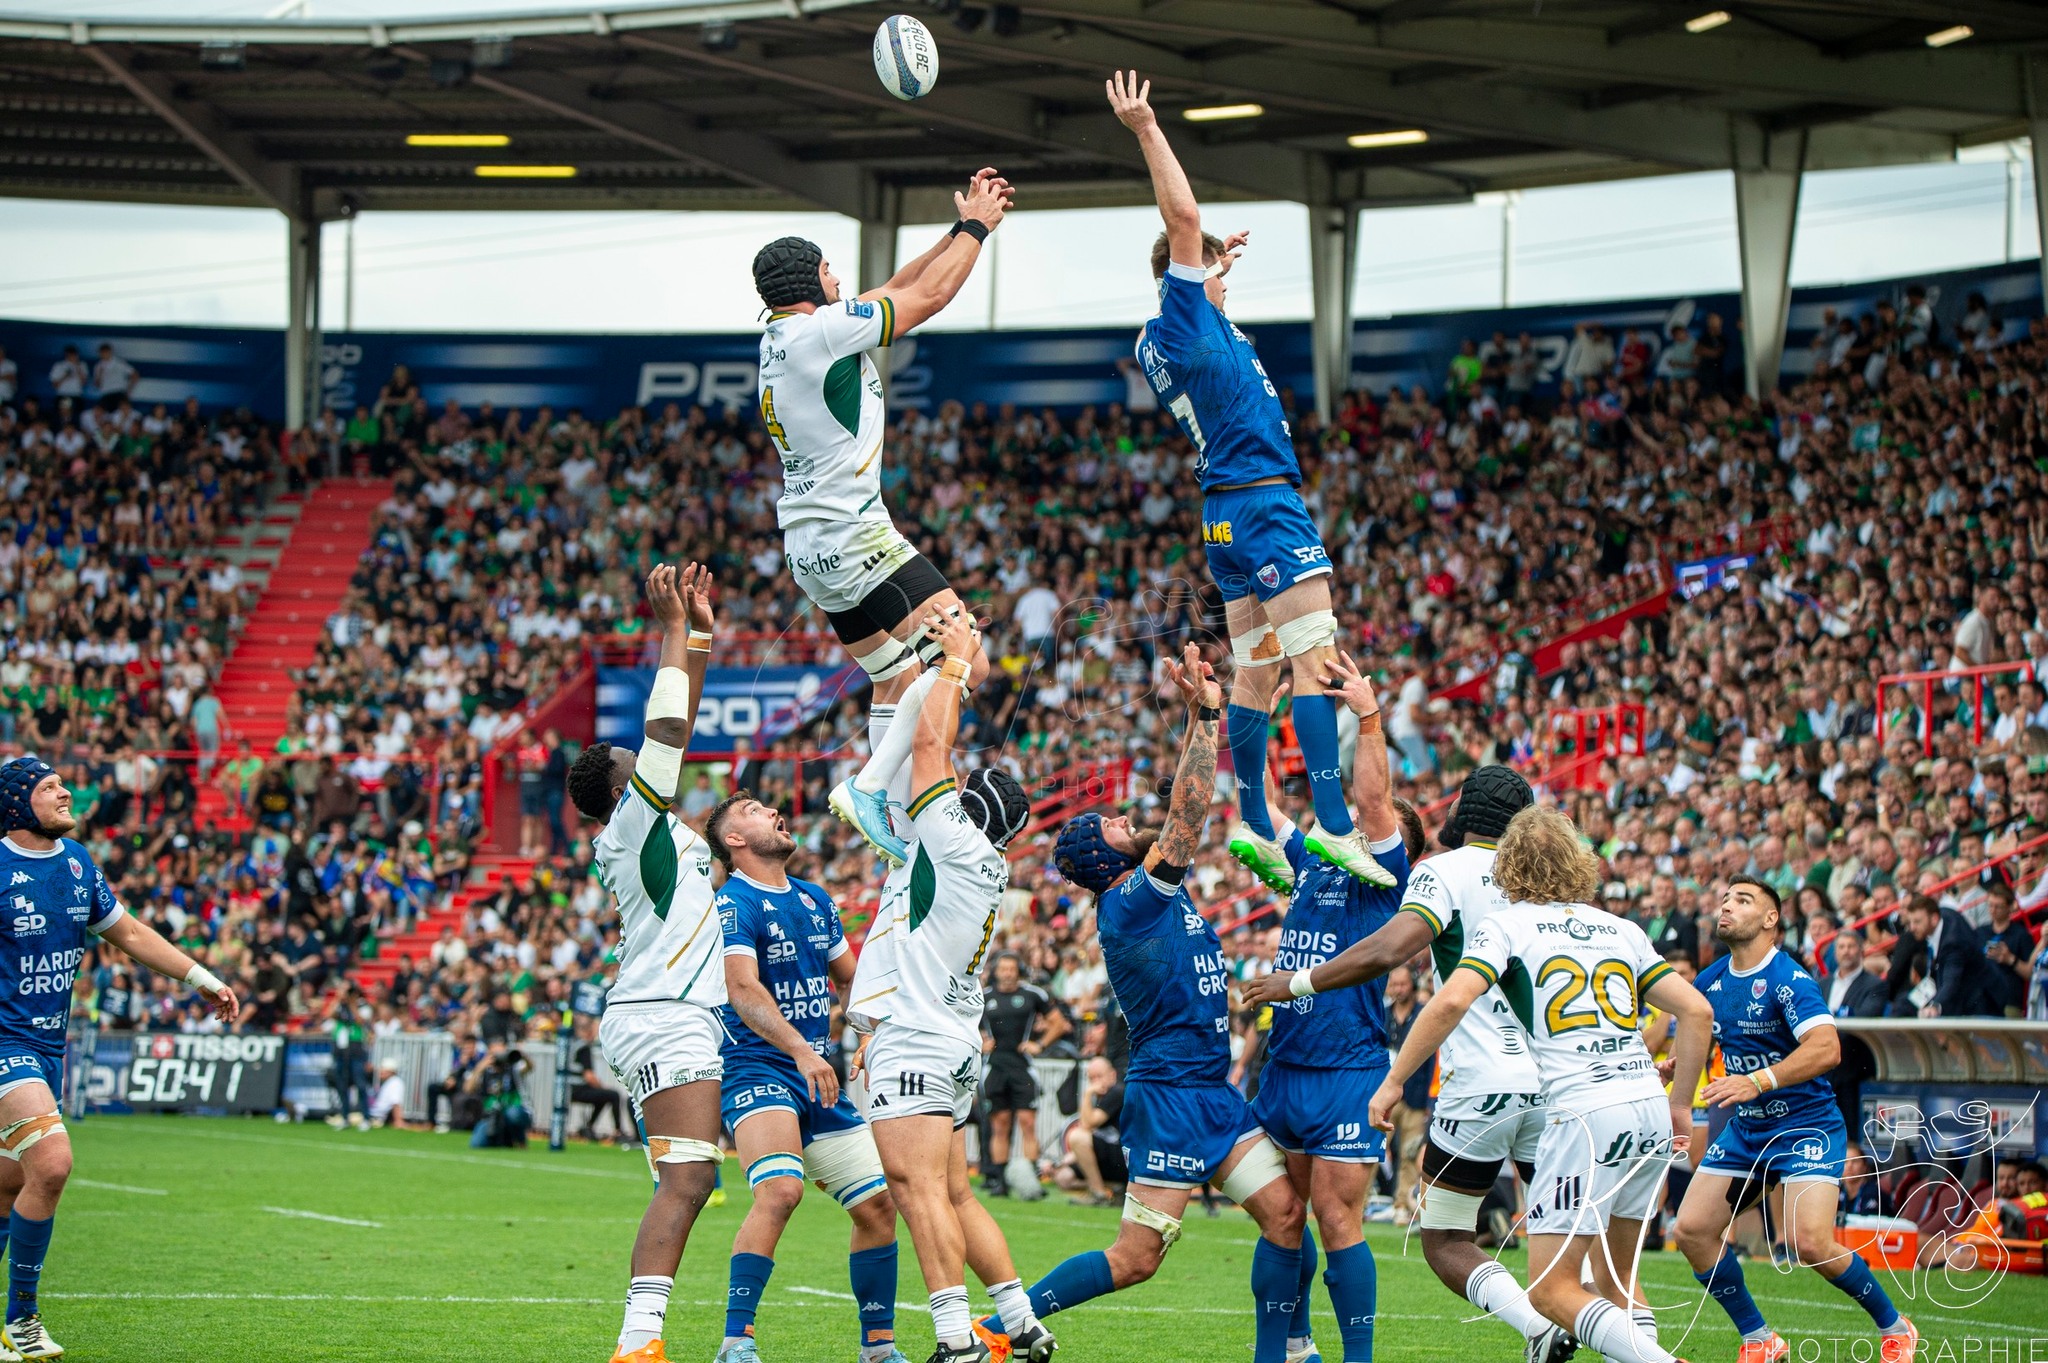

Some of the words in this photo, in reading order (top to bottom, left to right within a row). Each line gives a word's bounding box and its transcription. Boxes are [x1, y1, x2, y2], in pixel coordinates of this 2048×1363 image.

[761, 385, 792, 452] 4
[13, 914, 46, 932] SD
[14, 928, 47, 938] SERVICES
[767, 940, 796, 959] SD
[767, 955, 798, 965] SERVICES
[1193, 949, 1227, 975] HAR
[1198, 972, 1228, 997] GRO
[1535, 954, 1638, 1038] 20
[778, 997, 830, 1021] GROU
[174, 1035, 284, 1062] TISSOT
[1167, 1154, 1205, 1172] ECM
[728, 1287, 750, 1297] CG
[1711, 1285, 1737, 1299] CG
[1041, 1289, 1061, 1314] FC
[1266, 1301, 1295, 1313] FC
[1350, 1314, 1375, 1326] FC
